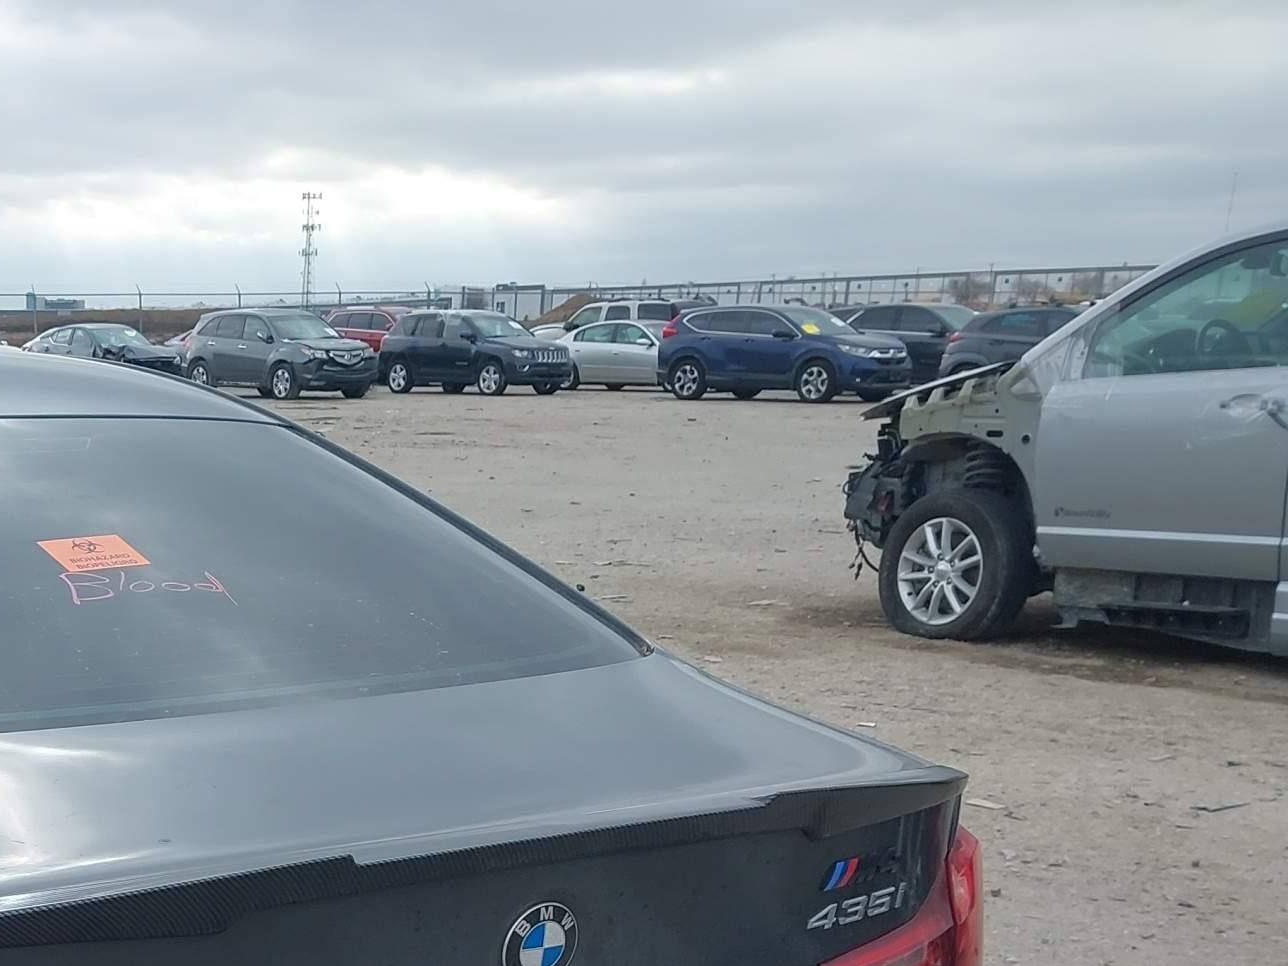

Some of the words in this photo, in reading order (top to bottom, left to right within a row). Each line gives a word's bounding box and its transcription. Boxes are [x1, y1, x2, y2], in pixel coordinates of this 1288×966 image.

[69, 552, 131, 564] BIOHAZARD
[59, 570, 239, 606] Blood
[514, 905, 574, 938] BMW
[806, 881, 907, 930] 435i
